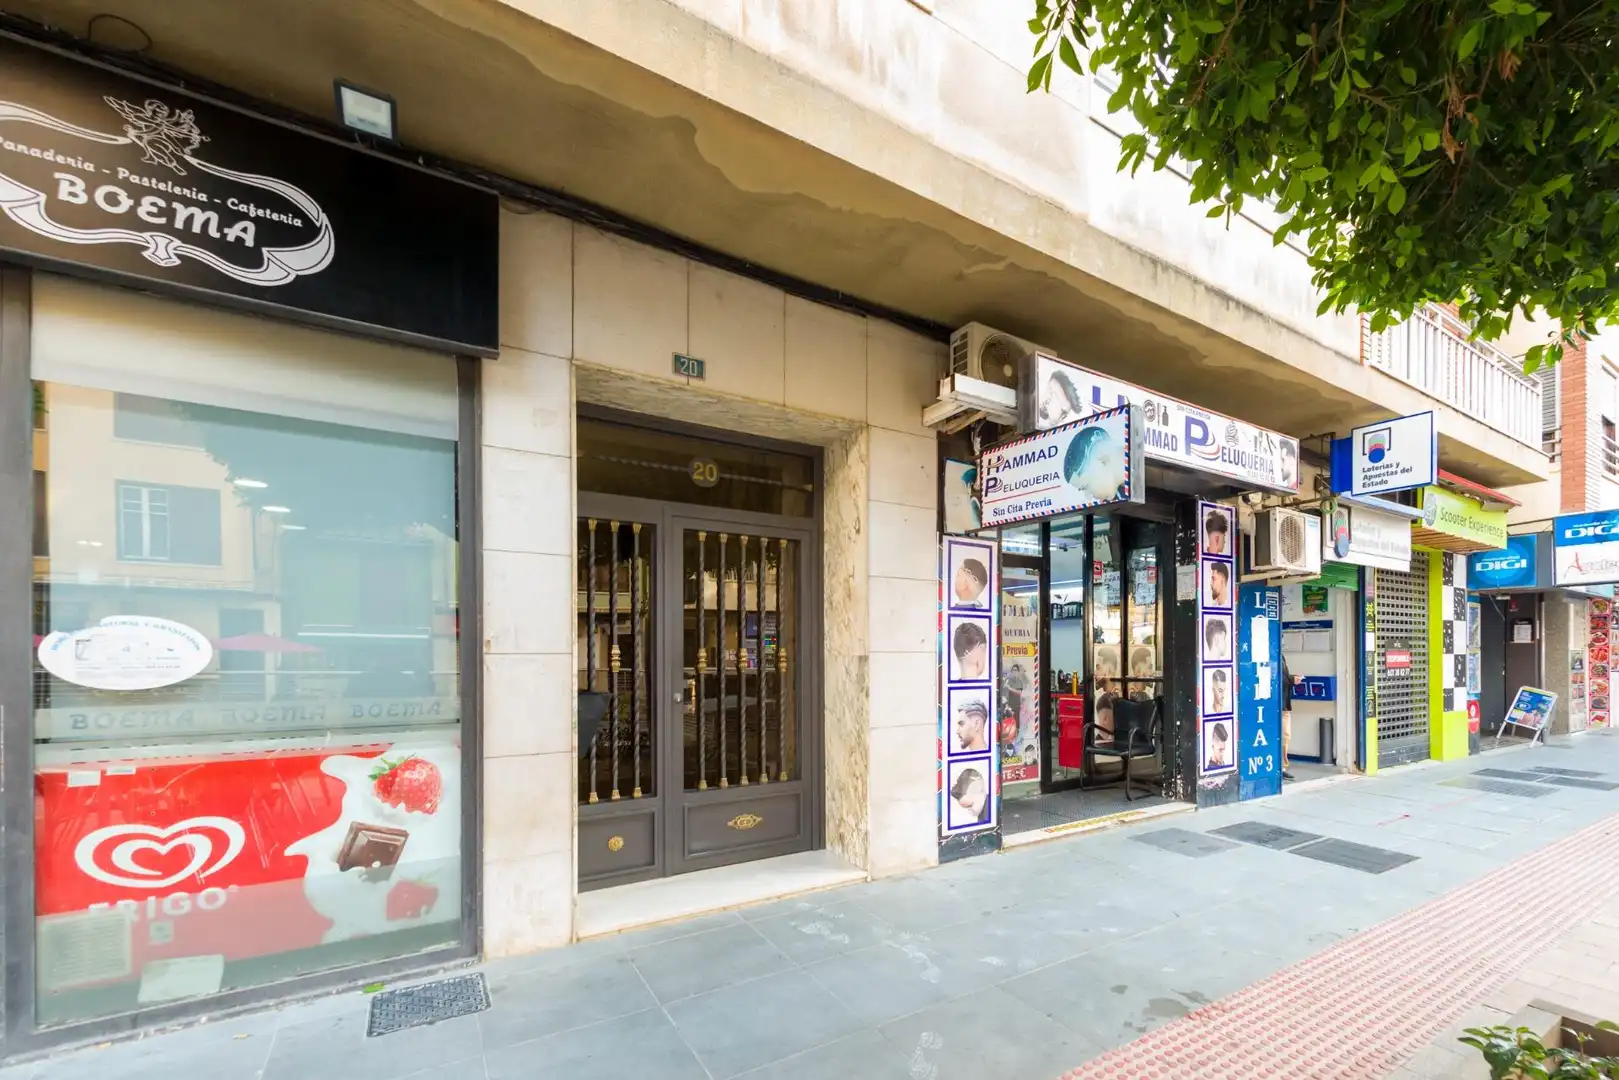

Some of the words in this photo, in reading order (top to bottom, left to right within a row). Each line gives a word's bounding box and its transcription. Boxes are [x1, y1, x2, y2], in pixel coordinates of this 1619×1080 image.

[0, 136, 96, 172] anaderia
[53, 172, 256, 248] BOEMA
[680, 358, 698, 376] 20
[1184, 415, 1275, 476] PELUQUERIA
[986, 445, 1059, 476] HAMMAD
[1395, 461, 1401, 470] y
[693, 462, 718, 482] 20
[1362, 469, 1398, 481] Apuestas
[1400, 466, 1413, 475] del
[984, 471, 1060, 497] PELUQUERIA
[1362, 479, 1389, 489] Estado
[992, 504, 1006, 517] Sin
[1007, 503, 1023, 514] Cita
[1025, 497, 1053, 511] Previa
[1440, 507, 1468, 529] Scooter
[1468, 516, 1504, 538] Experience
[1475, 559, 1528, 572] DIGI
[1006, 645, 1029, 656] Previa
[70, 708, 194, 730] BOEMA
[350, 701, 442, 719] BOEMA
[1265, 755, 1273, 772] 3
